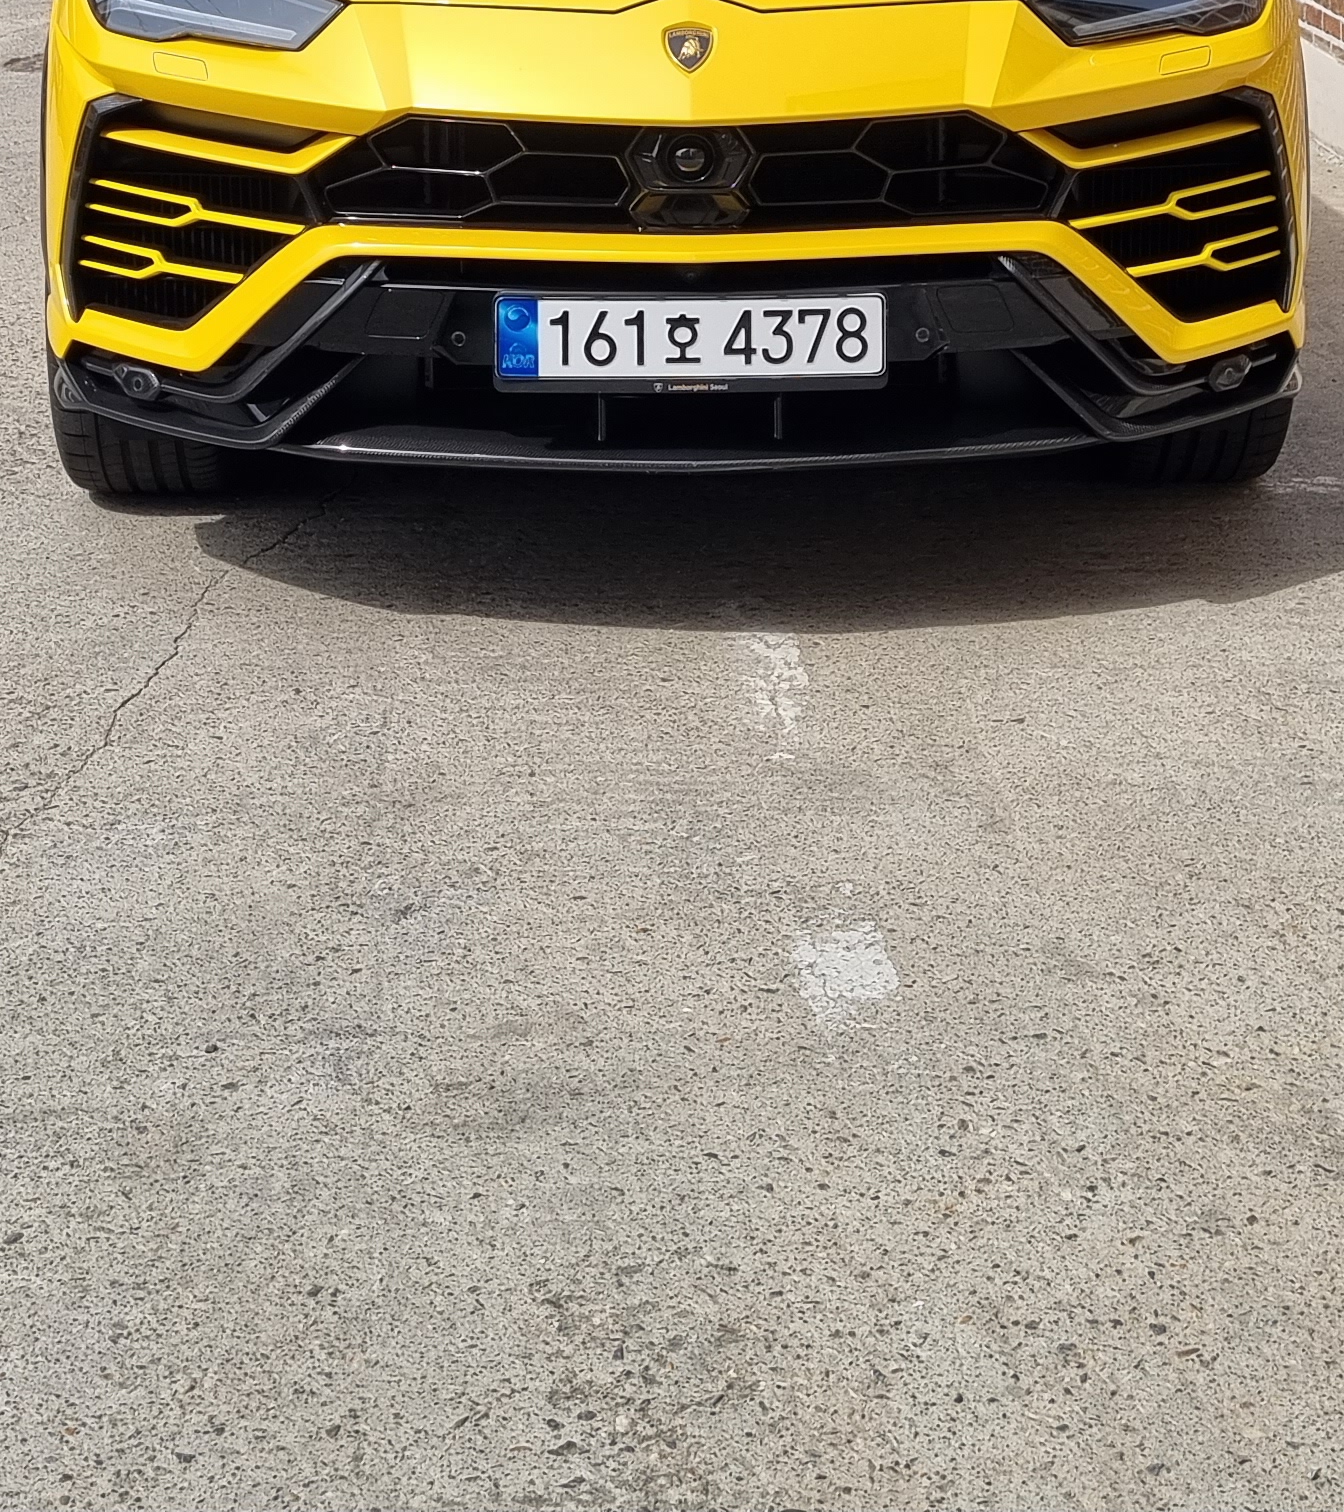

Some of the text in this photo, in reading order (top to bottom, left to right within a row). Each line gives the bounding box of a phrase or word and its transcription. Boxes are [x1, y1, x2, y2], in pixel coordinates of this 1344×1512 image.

[549, 308, 869, 366] 161호 4378
[668, 383, 729, 392] Lamborghini Seoul
